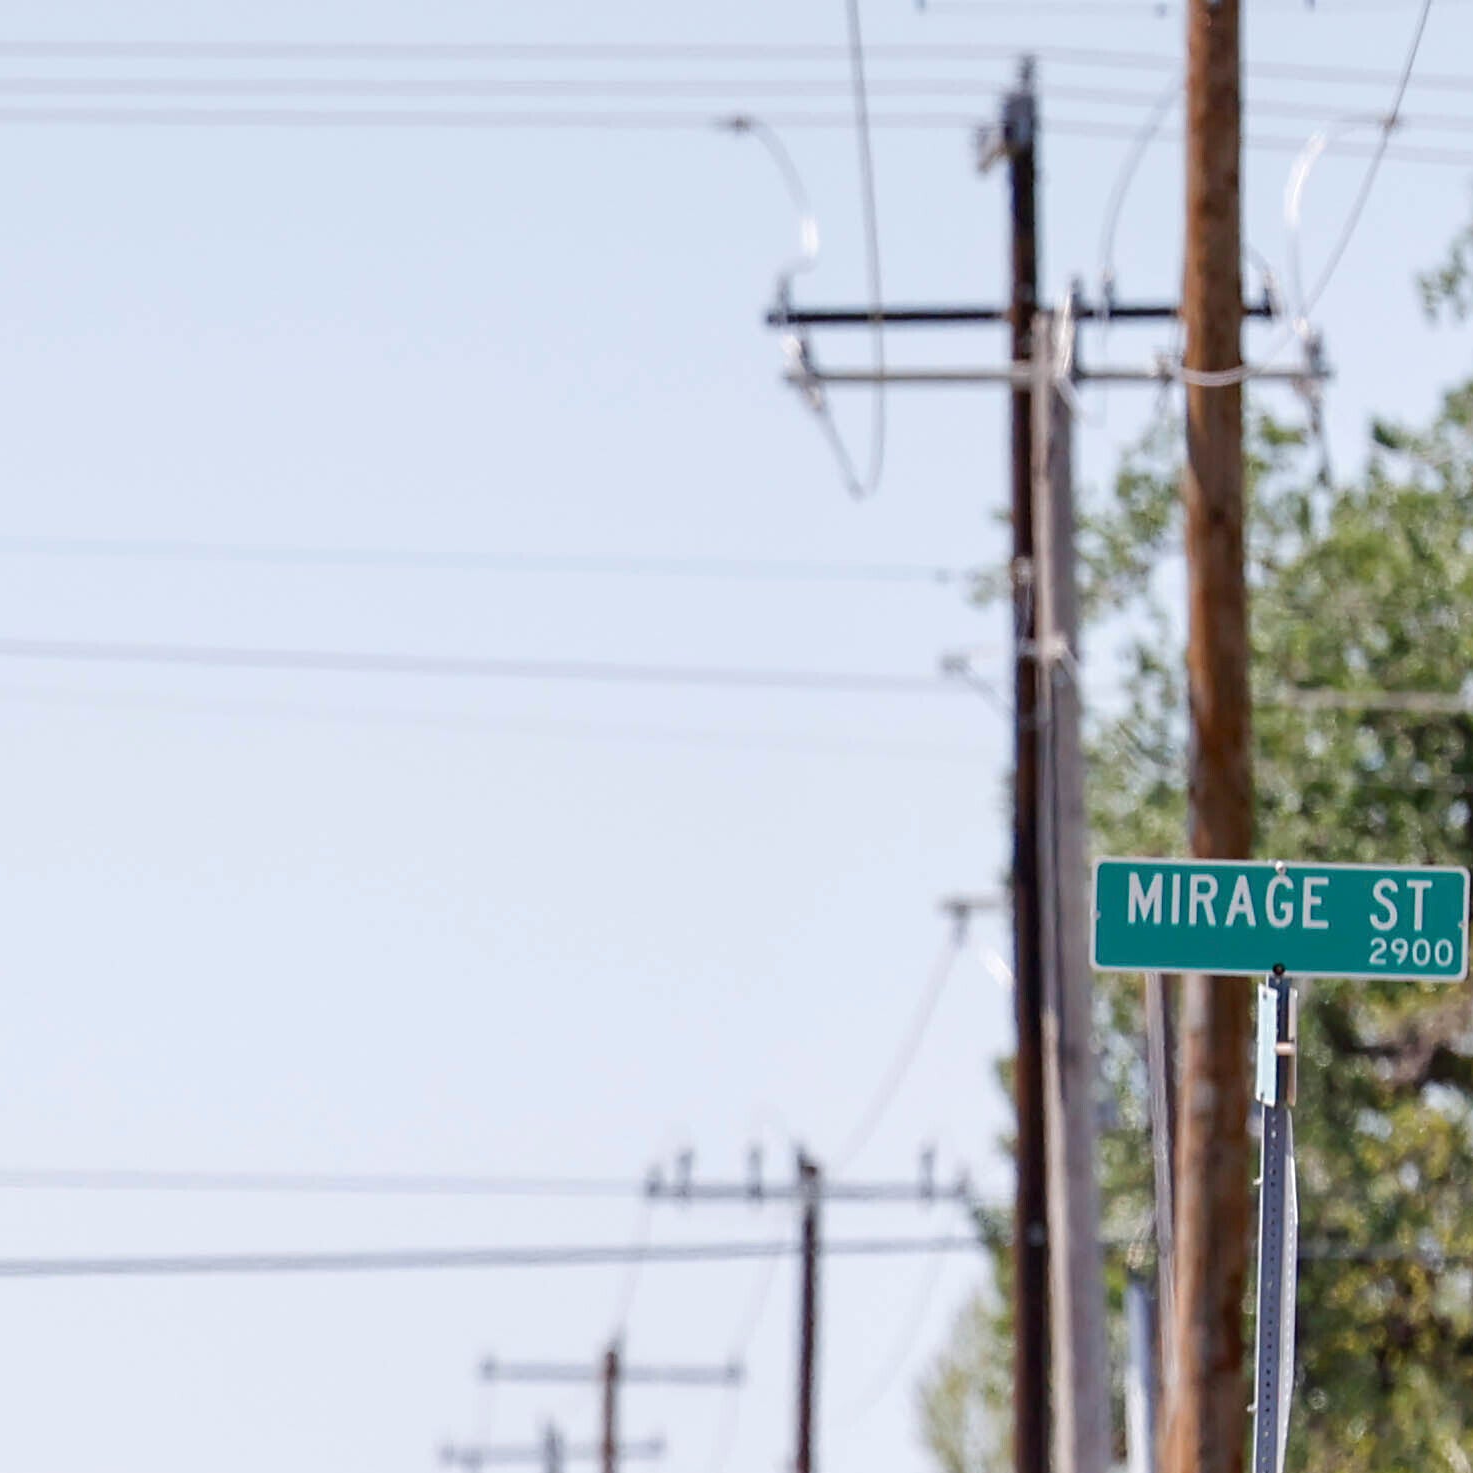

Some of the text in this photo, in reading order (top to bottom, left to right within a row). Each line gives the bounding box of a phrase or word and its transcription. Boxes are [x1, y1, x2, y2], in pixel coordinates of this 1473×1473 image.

[1127, 872, 1433, 932] MIRAGE ST
[1369, 938, 1454, 967] 2900
